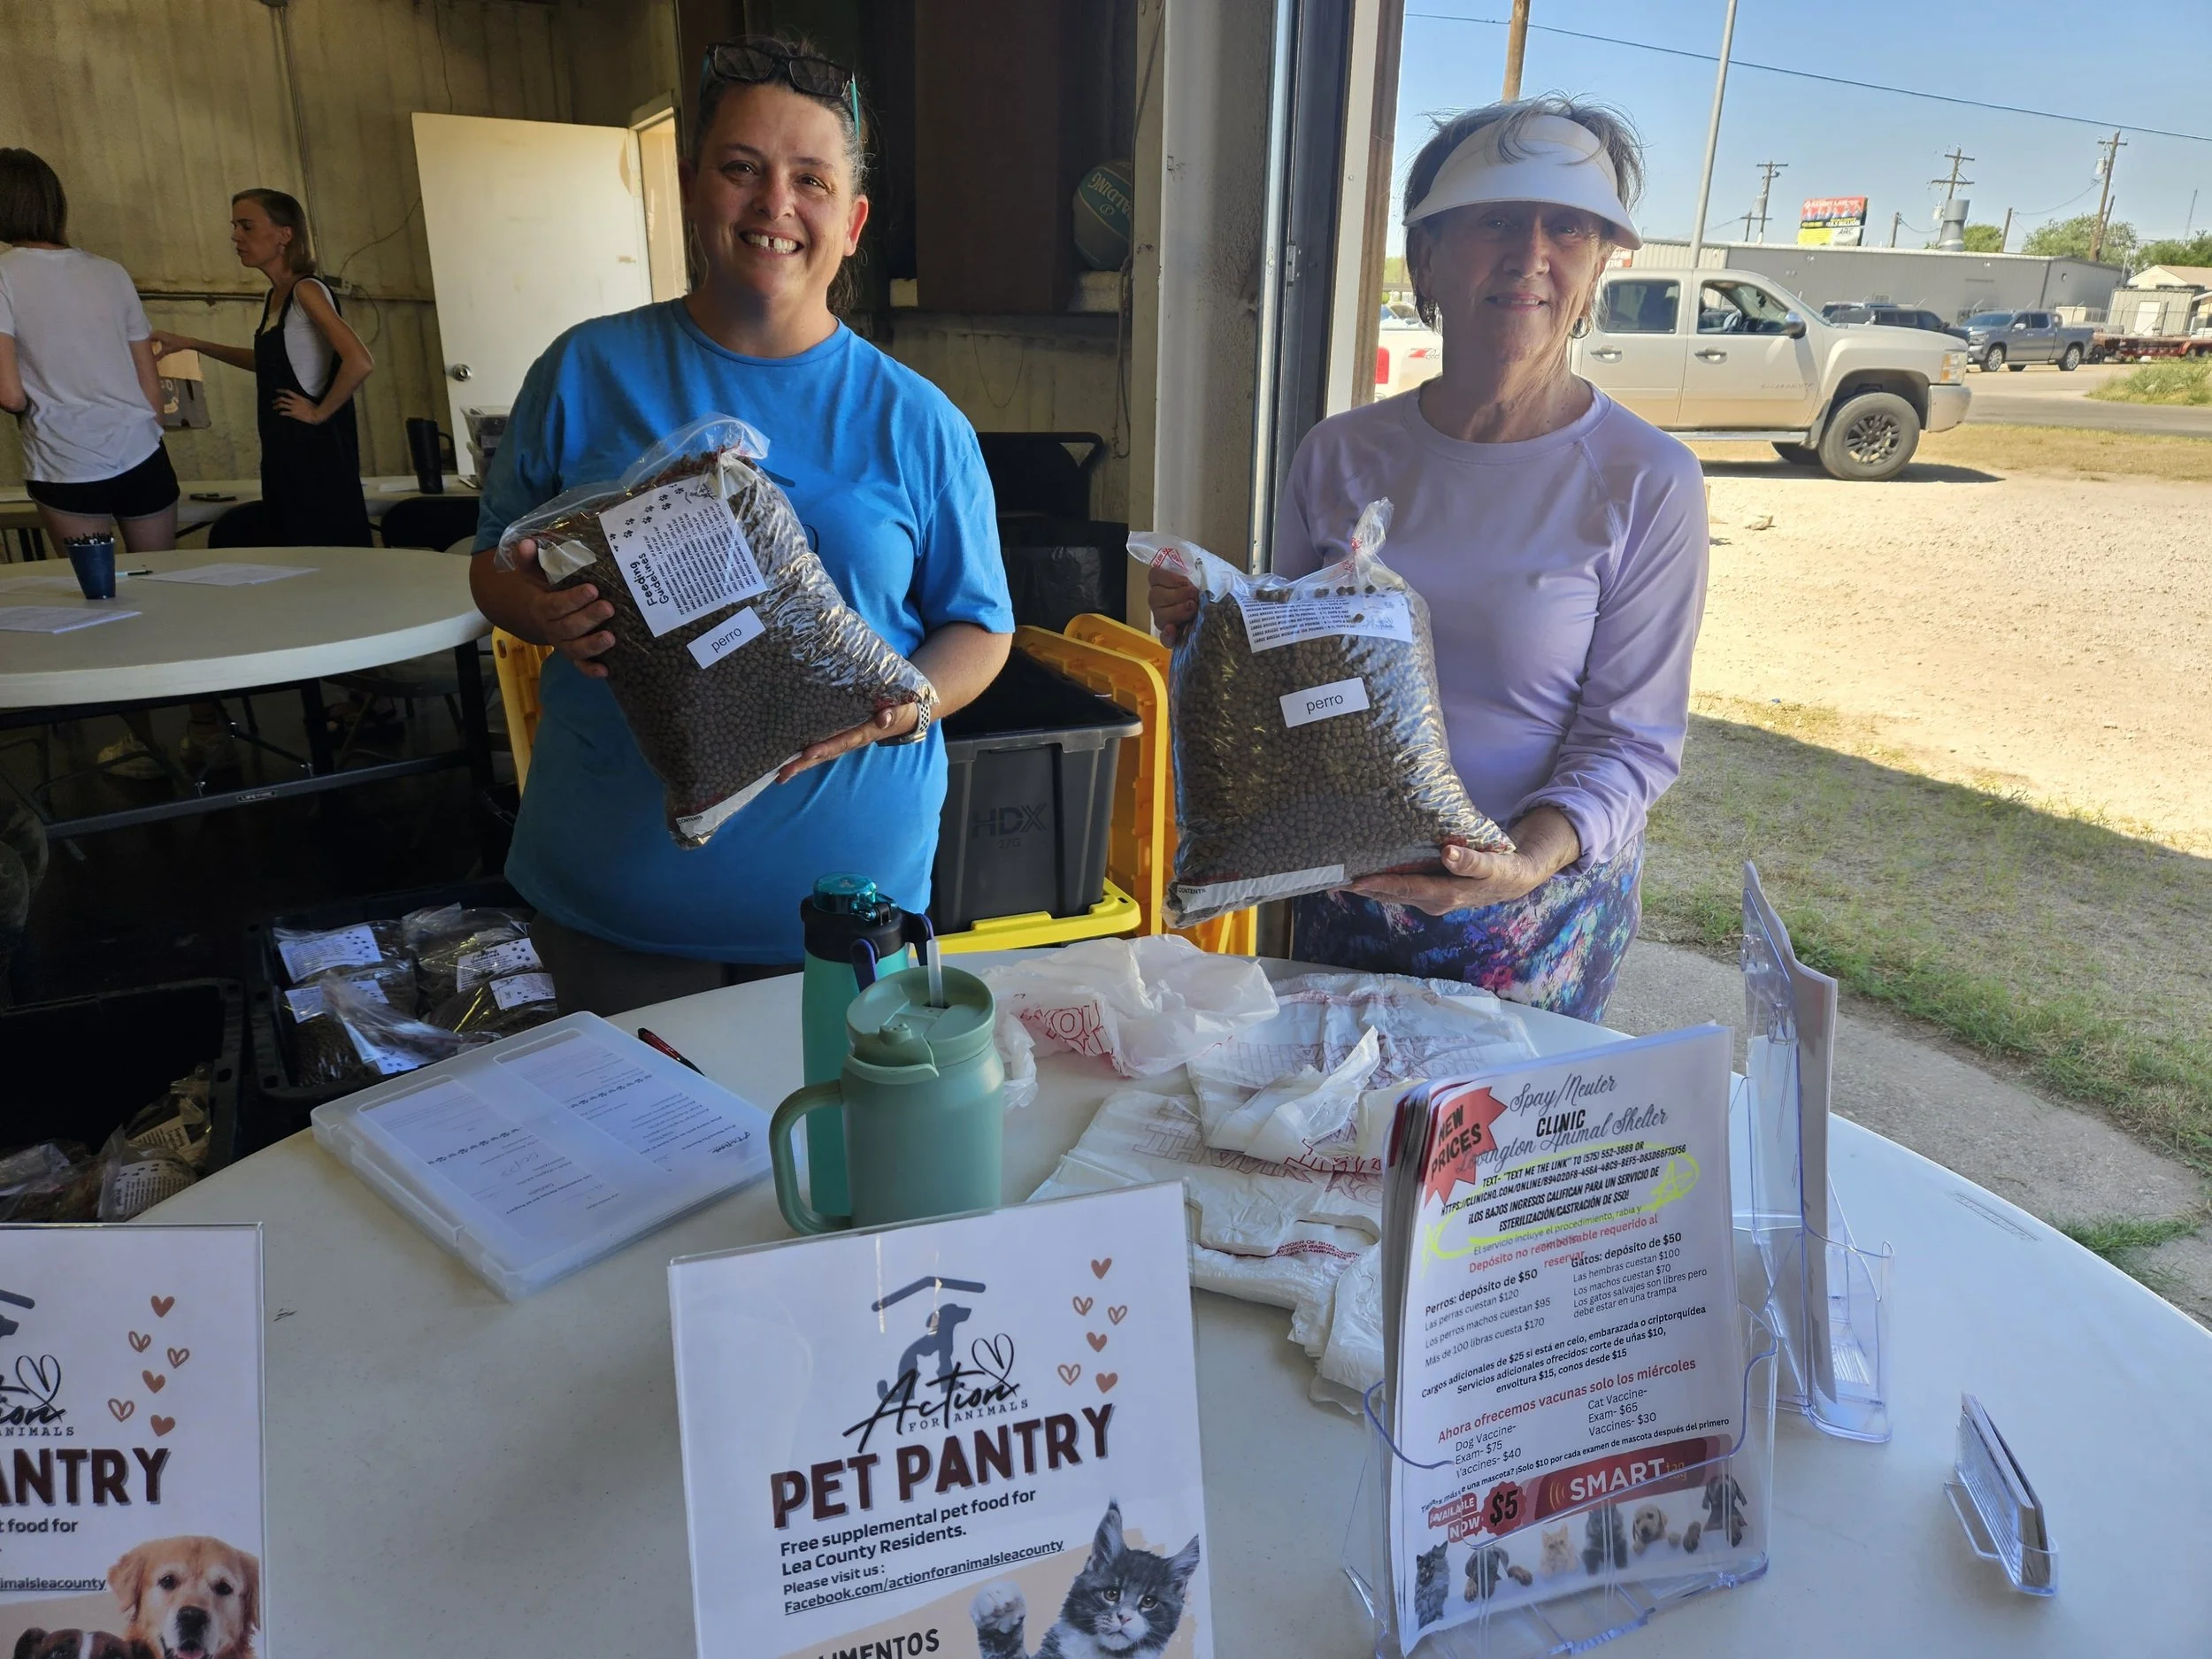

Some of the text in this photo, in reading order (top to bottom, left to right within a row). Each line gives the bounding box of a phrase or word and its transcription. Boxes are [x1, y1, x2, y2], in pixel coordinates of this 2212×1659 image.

[1087, 172, 1131, 214] ALDING
[629, 560, 656, 604] Feeding
[638, 552, 668, 602] Guidelines
[710, 625, 742, 653] perro
[1306, 691, 1344, 714] perro
[972, 803, 1047, 838] HDX
[1509, 1073, 1617, 1117] Spay/Neuter
[1439, 1104, 1463, 1145] NEW
[1536, 1110, 1586, 1137] CLINIC
[1540, 1112, 1613, 1152] Animal
[1612, 1104, 1668, 1135] Shelter
[1431, 1123, 1482, 1180] PRICES
[1483, 1175, 1501, 1188] TEXT-
[1525, 1167, 1536, 1177] ME
[1537, 1163, 1550, 1175] THE
[1583, 1151, 1600, 1164] (575)
[1485, 1203, 1508, 1219] BAJOS
[1509, 1192, 1545, 1212] INGRESOS
[1546, 1185, 1583, 1202] CALIFICAN
[1584, 1179, 1603, 1193] PARA
[1617, 1170, 1649, 1187] SERVICIO
[1279, 1240, 1304, 1249] ANGER
[1469, 1252, 1513, 1273] Depósito
[1600, 1217, 1647, 1238] requerido
[1482, 1238, 1513, 1253] servicio
[1515, 1229, 1544, 1243] incluye
[1544, 1250, 1585, 1268] reservar
[1571, 1232, 1681, 1268] Gatos: depósito de $50
[1573, 1264, 1671, 1296] Los machos cuestan $70
[1589, 1248, 1680, 1279] hembras cuestan $100
[1425, 1269, 1538, 1317] Perros: depósito de $50
[1439, 1289, 1519, 1325] perras cuestan $120
[1573, 1270, 1707, 1308] Los gatos salvajes son libres pero
[1573, 1286, 1677, 1318] debe estar una trampa
[1440, 1297, 1551, 1343] perros machos cuestan $95
[1452, 1317, 1545, 1355] 100 libras cuesta $170
[1421, 1305, 1706, 1398] Cargos adicionales $25 está celo, embarazada criptorquídea
[1457, 1327, 1666, 1394] Servicios adicionales ofrecidos: corte uñas $10,
[1496, 1362, 1584, 1393] envoltura $15, conos
[842, 1361, 1020, 1454] Action
[909, 1399, 1029, 1432] FOR ANIMALS
[1438, 1359, 1696, 1443] Ahora ofrecemos vacunas solo los miércoles
[1587, 1389, 1647, 1409] Cat Vaccine-
[1588, 1402, 1638, 1423] Exam- $65
[0, 1426, 74, 1436] NIMALS
[1455, 1425, 1516, 1451] Dog Vaccine-
[1589, 1412, 1657, 1436] Vaccines- $30
[771, 1404, 1116, 1530] PET PANTRY
[1455, 1440, 1502, 1465] Exam- $75
[1467, 1480, 1480, 1490] una
[1481, 1468, 1515, 1485] mascota?
[1535, 1457, 1549, 1468] $10
[1550, 1454, 1562, 1465] por
[1564, 1449, 1581, 1459] cada
[1583, 1443, 1609, 1455] examen
[1622, 1432, 1652, 1445] mascota
[1654, 1426, 1684, 1440] después
[1686, 1423, 1697, 1431] del
[1699, 1419, 1729, 1431] primero
[1503, 1448, 1522, 1462] $40
[0, 1448, 170, 1505] NTRY
[1570, 1458, 1665, 1501] SMART
[8, 1518, 78, 1533] food for
[780, 1490, 1036, 1557] Free supplemental pet food for
[1490, 1490, 1518, 1526] $5
[1449, 1515, 1480, 1539] NOW
[782, 1525, 967, 1576] Lea County Residents.
[783, 1577, 829, 1595] Please
[831, 1569, 861, 1584] visit
[784, 1540, 1064, 1614] Facebook.com/actionforanimalsleacounty
